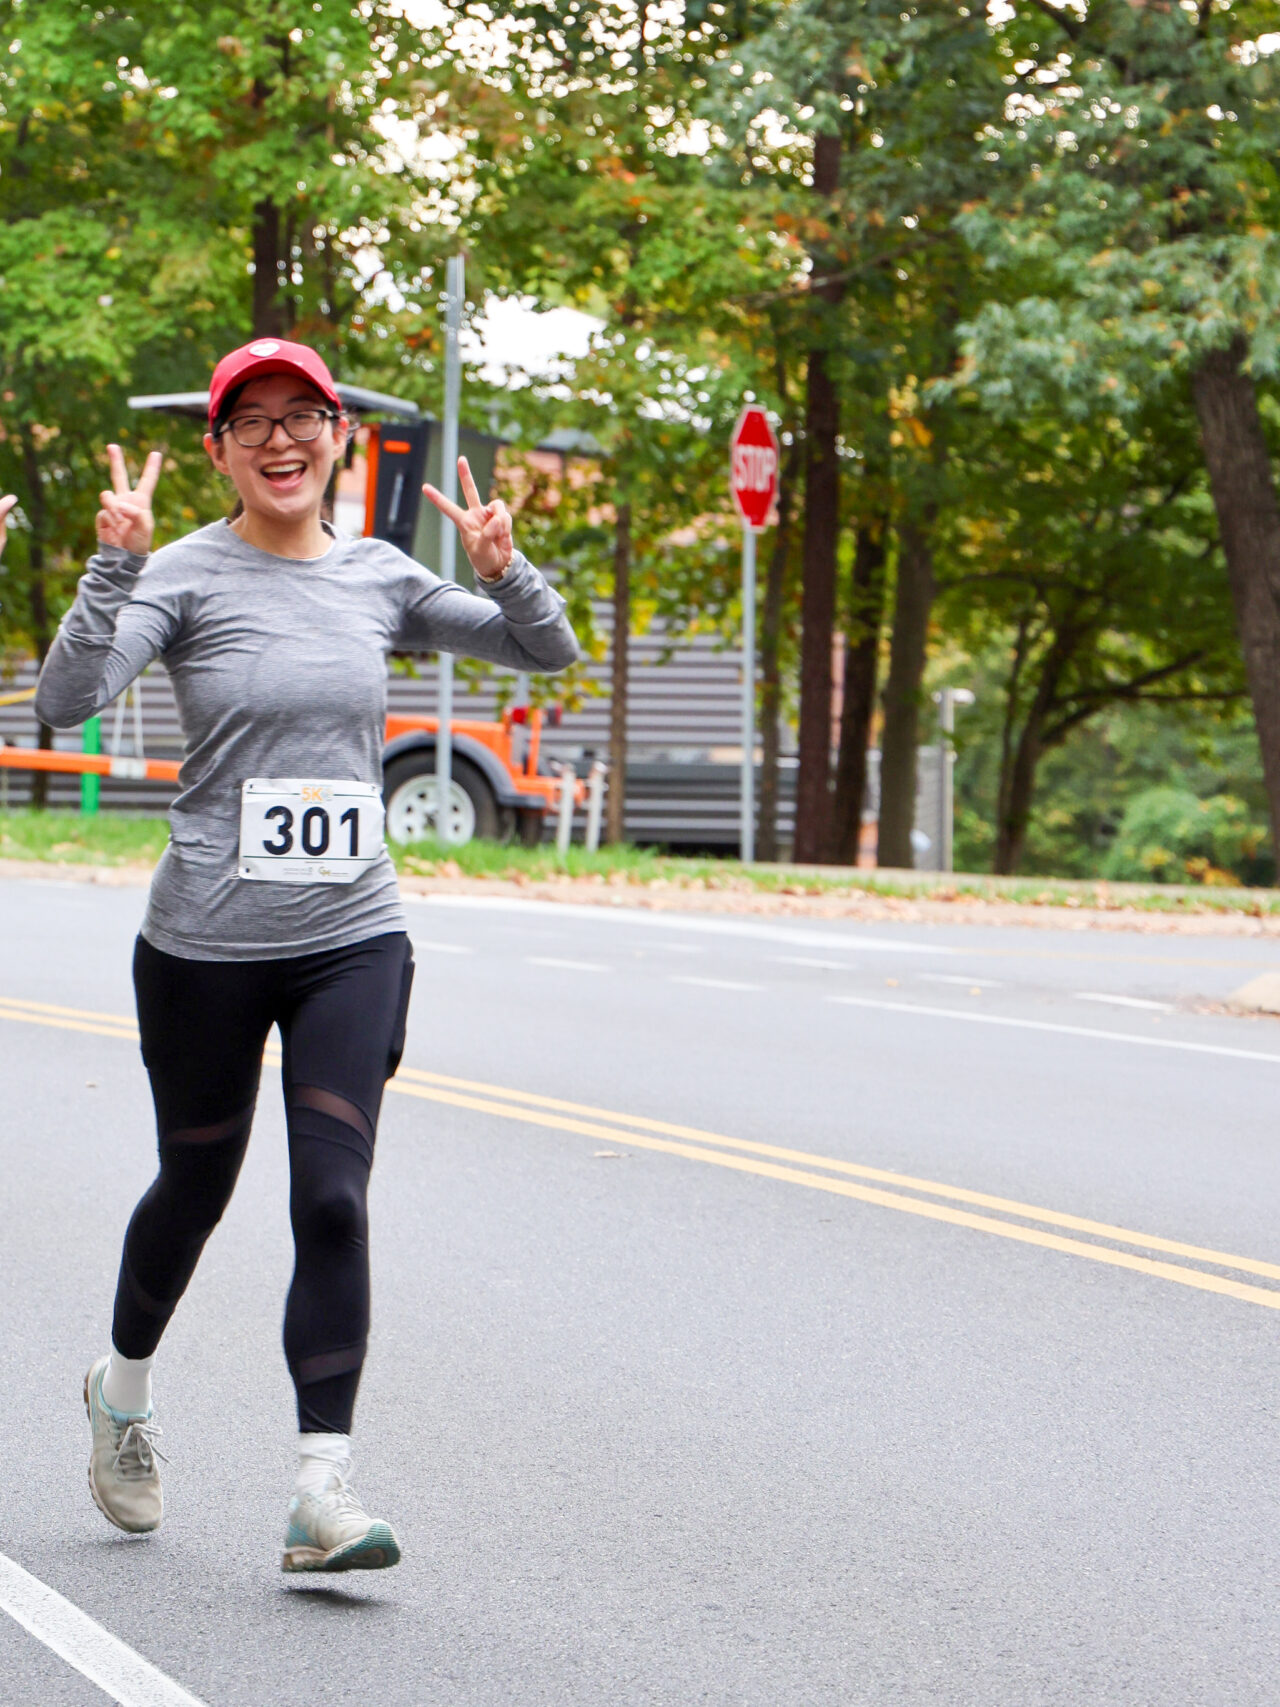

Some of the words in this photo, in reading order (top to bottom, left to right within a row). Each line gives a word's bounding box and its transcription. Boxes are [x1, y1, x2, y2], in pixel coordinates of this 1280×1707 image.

[734, 444, 777, 492] STOP
[301, 787, 323, 802] 5K
[262, 805, 359, 857] 301
